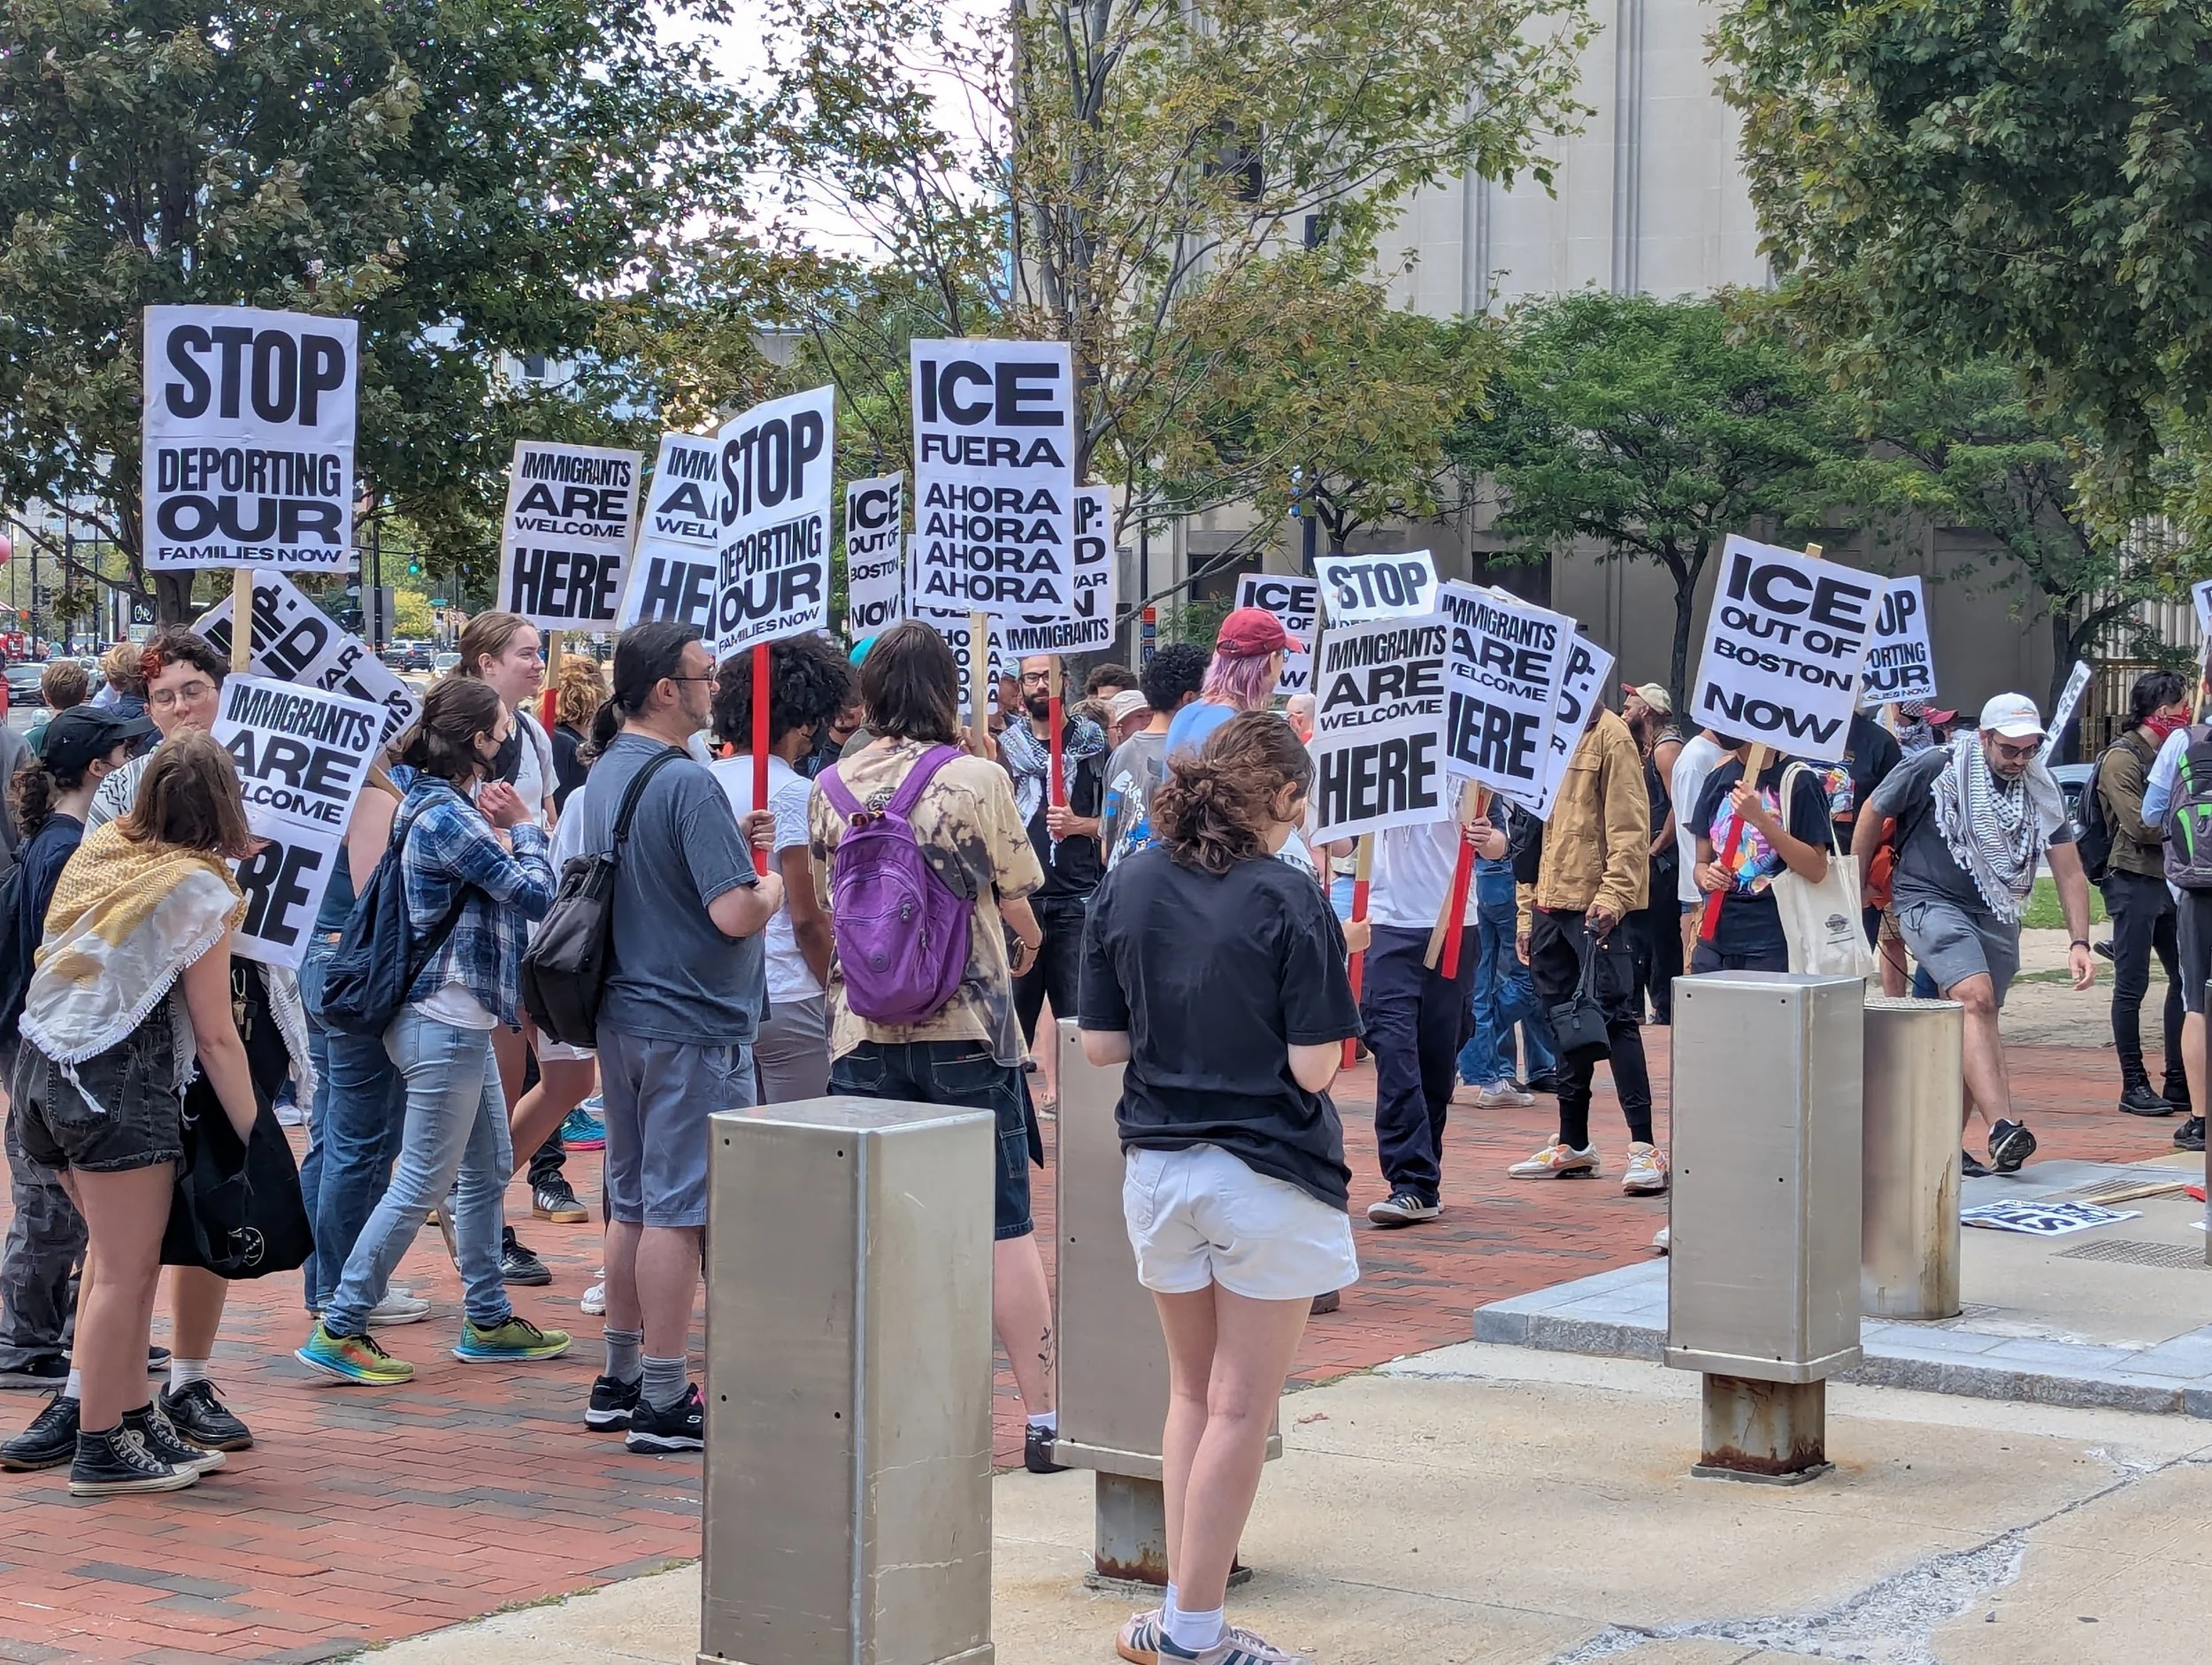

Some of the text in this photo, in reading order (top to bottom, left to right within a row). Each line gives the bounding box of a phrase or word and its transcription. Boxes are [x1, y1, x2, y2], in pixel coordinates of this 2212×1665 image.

[165, 325, 346, 426] STOP
[920, 359, 1064, 427] ICE
[157, 447, 342, 497] DEPORTING
[521, 451, 632, 487] IMMIGRANTS
[721, 410, 824, 528] STOP
[921, 433, 1065, 468] FUERA
[157, 495, 342, 545] OUR
[515, 482, 628, 522] ARE
[849, 482, 901, 532] ICE
[924, 482, 1063, 515] AHORA
[515, 516, 626, 538] WELCOME
[849, 526, 900, 556] OUT OF
[925, 511, 1063, 545] AHORA
[158, 546, 342, 564] FAMILIES NOW
[719, 515, 822, 592] DEPORTING
[849, 557, 899, 582] BOSTON
[925, 541, 1063, 574] AHORA
[511, 547, 621, 620] HERE
[639, 556, 718, 641] HE
[719, 562, 821, 633] OUR
[925, 570, 1063, 604] AHORA
[1242, 580, 1317, 614] ICE
[1326, 561, 1428, 610] STOP
[1726, 553, 1872, 634] ICE
[718, 605, 821, 654] FAMILIES NOW
[851, 593, 899, 629] NOW
[1006, 618, 1110, 651] IMMIGRANTS
[1286, 617, 1315, 631] OF
[1441, 594, 1557, 651] IMMIGRANTS
[1720, 606, 1862, 659] OUT OF
[1875, 589, 1917, 637] OP
[1326, 625, 1447, 673] IMMIGRANTS
[1451, 626, 1553, 687] ARE
[1713, 636, 1854, 692] BOSTON
[1865, 641, 1926, 669] ORTING
[1320, 658, 1444, 713] ARE
[1901, 685, 1932, 697] NOW
[227, 683, 375, 753] IMMIGRANTS
[1319, 699, 1443, 732] WELCOME
[1703, 681, 1844, 745] NOW
[225, 730, 362, 802] ARE
[1317, 732, 1438, 829] HERE
[240, 782, 345, 825] LCOME
[236, 840, 323, 948] RE
